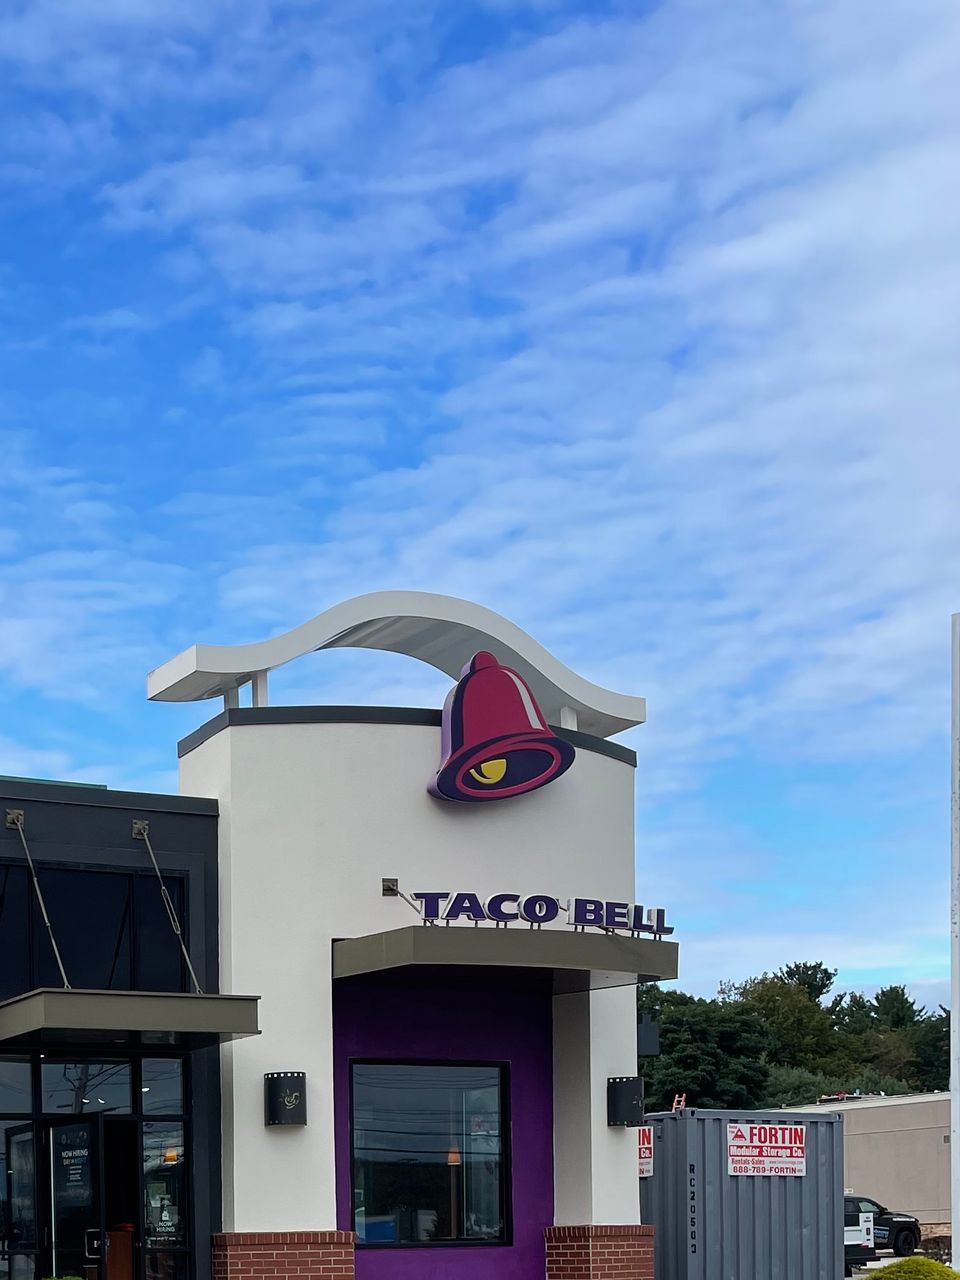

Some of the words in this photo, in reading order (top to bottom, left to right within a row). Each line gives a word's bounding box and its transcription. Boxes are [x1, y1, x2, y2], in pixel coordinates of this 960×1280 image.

[412, 892, 559, 924] TACO
[569, 897, 675, 936] BELL
[749, 1126, 804, 1145] FORTIN
[730, 1146, 760, 1157] Modular
[792, 1147, 804, 1157] Co.
